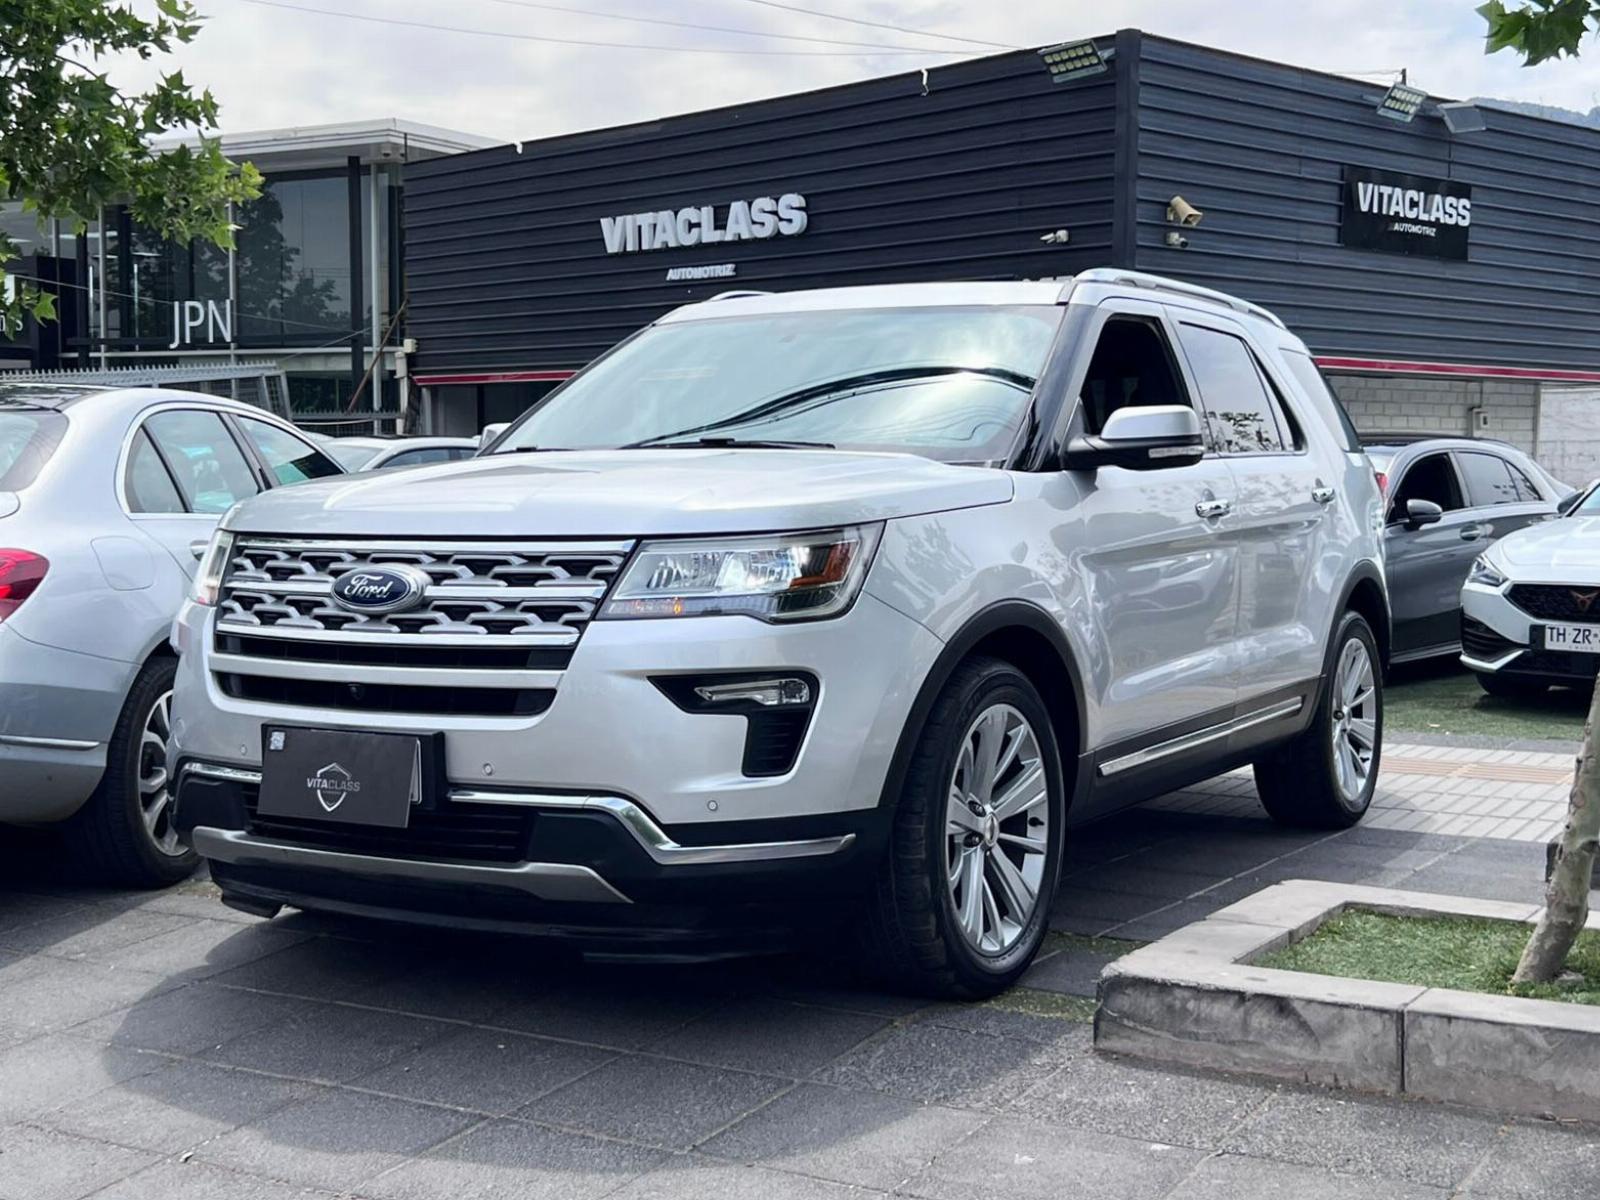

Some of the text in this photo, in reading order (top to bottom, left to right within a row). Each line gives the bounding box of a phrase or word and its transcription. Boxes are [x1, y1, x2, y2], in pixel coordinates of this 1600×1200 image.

[1358, 181, 1472, 226] VITACLASS
[600, 193, 807, 254] VITACLASS
[1393, 222, 1437, 237] AUTOMOTRIZ
[666, 264, 736, 281] AUTOMOTRIZ
[169, 299, 232, 349] JPN
[344, 573, 394, 599] Ford
[307, 777, 361, 792] VITACLASS
